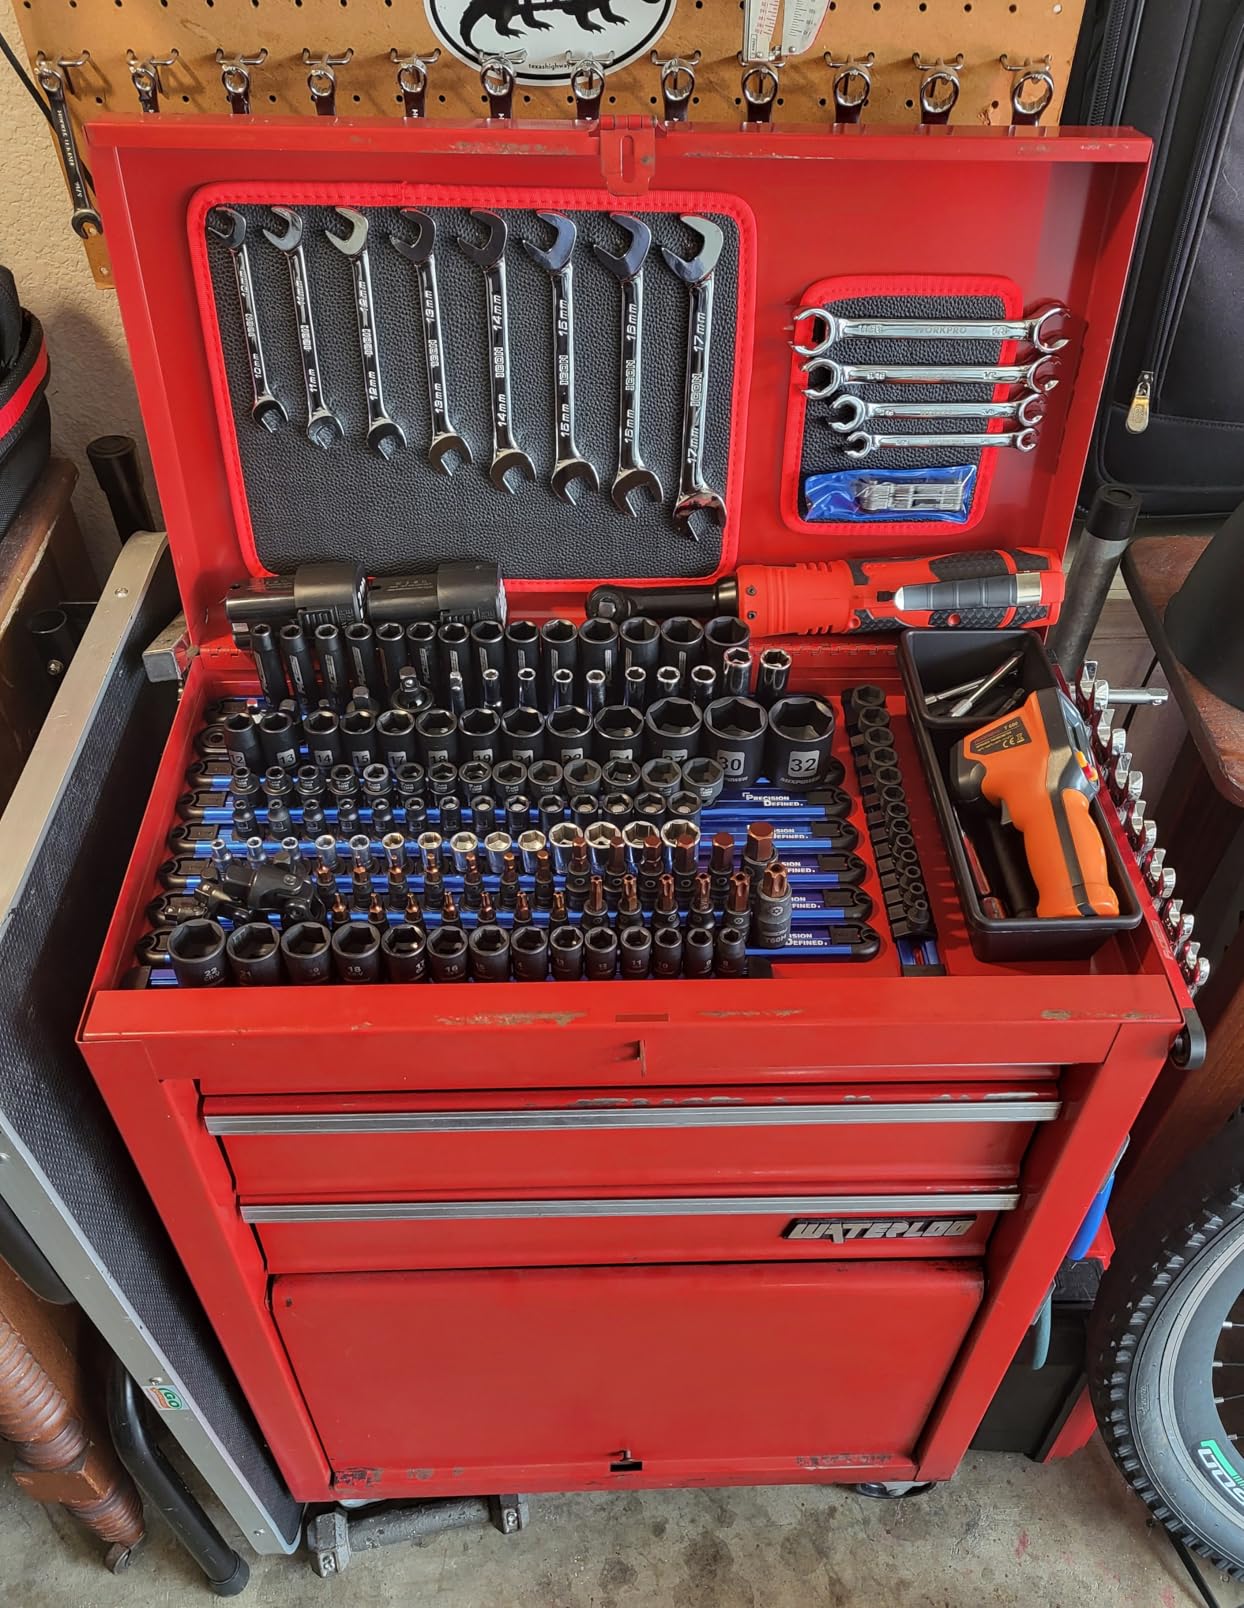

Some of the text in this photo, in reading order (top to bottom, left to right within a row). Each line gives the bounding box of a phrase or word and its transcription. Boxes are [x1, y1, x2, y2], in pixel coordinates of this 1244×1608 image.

[528, 62, 574, 72] texashighway
[426, 290, 434, 324] 13mm
[492, 294, 502, 331] 14mm
[626, 303, 638, 341] 16mm
[694, 312, 706, 352] 17mm
[912, 326, 968, 335] WORKPRO
[494, 346, 504, 378] ICON
[558, 354, 568, 386] ICON
[625, 359, 636, 391] ICON
[434, 383, 442, 414] 13mm
[690, 373, 704, 407] ICON
[498, 394, 508, 428] 14mm
[624, 408, 636, 444] 16mm
[686, 427, 699, 465] 17mm
[230, 755, 244, 764] 12
[280, 754, 294, 764] 13
[317, 754, 330, 764] 14
[355, 754, 368, 764] 15
[391, 755, 404, 765] 17
[719, 758, 742, 772] 30
[791, 758, 817, 772] 32
[204, 966, 218, 977] 22
[444, 965, 458, 973] 16
[632, 959, 642, 967] 11
[786, 1219, 977, 1244] WATERLOO
